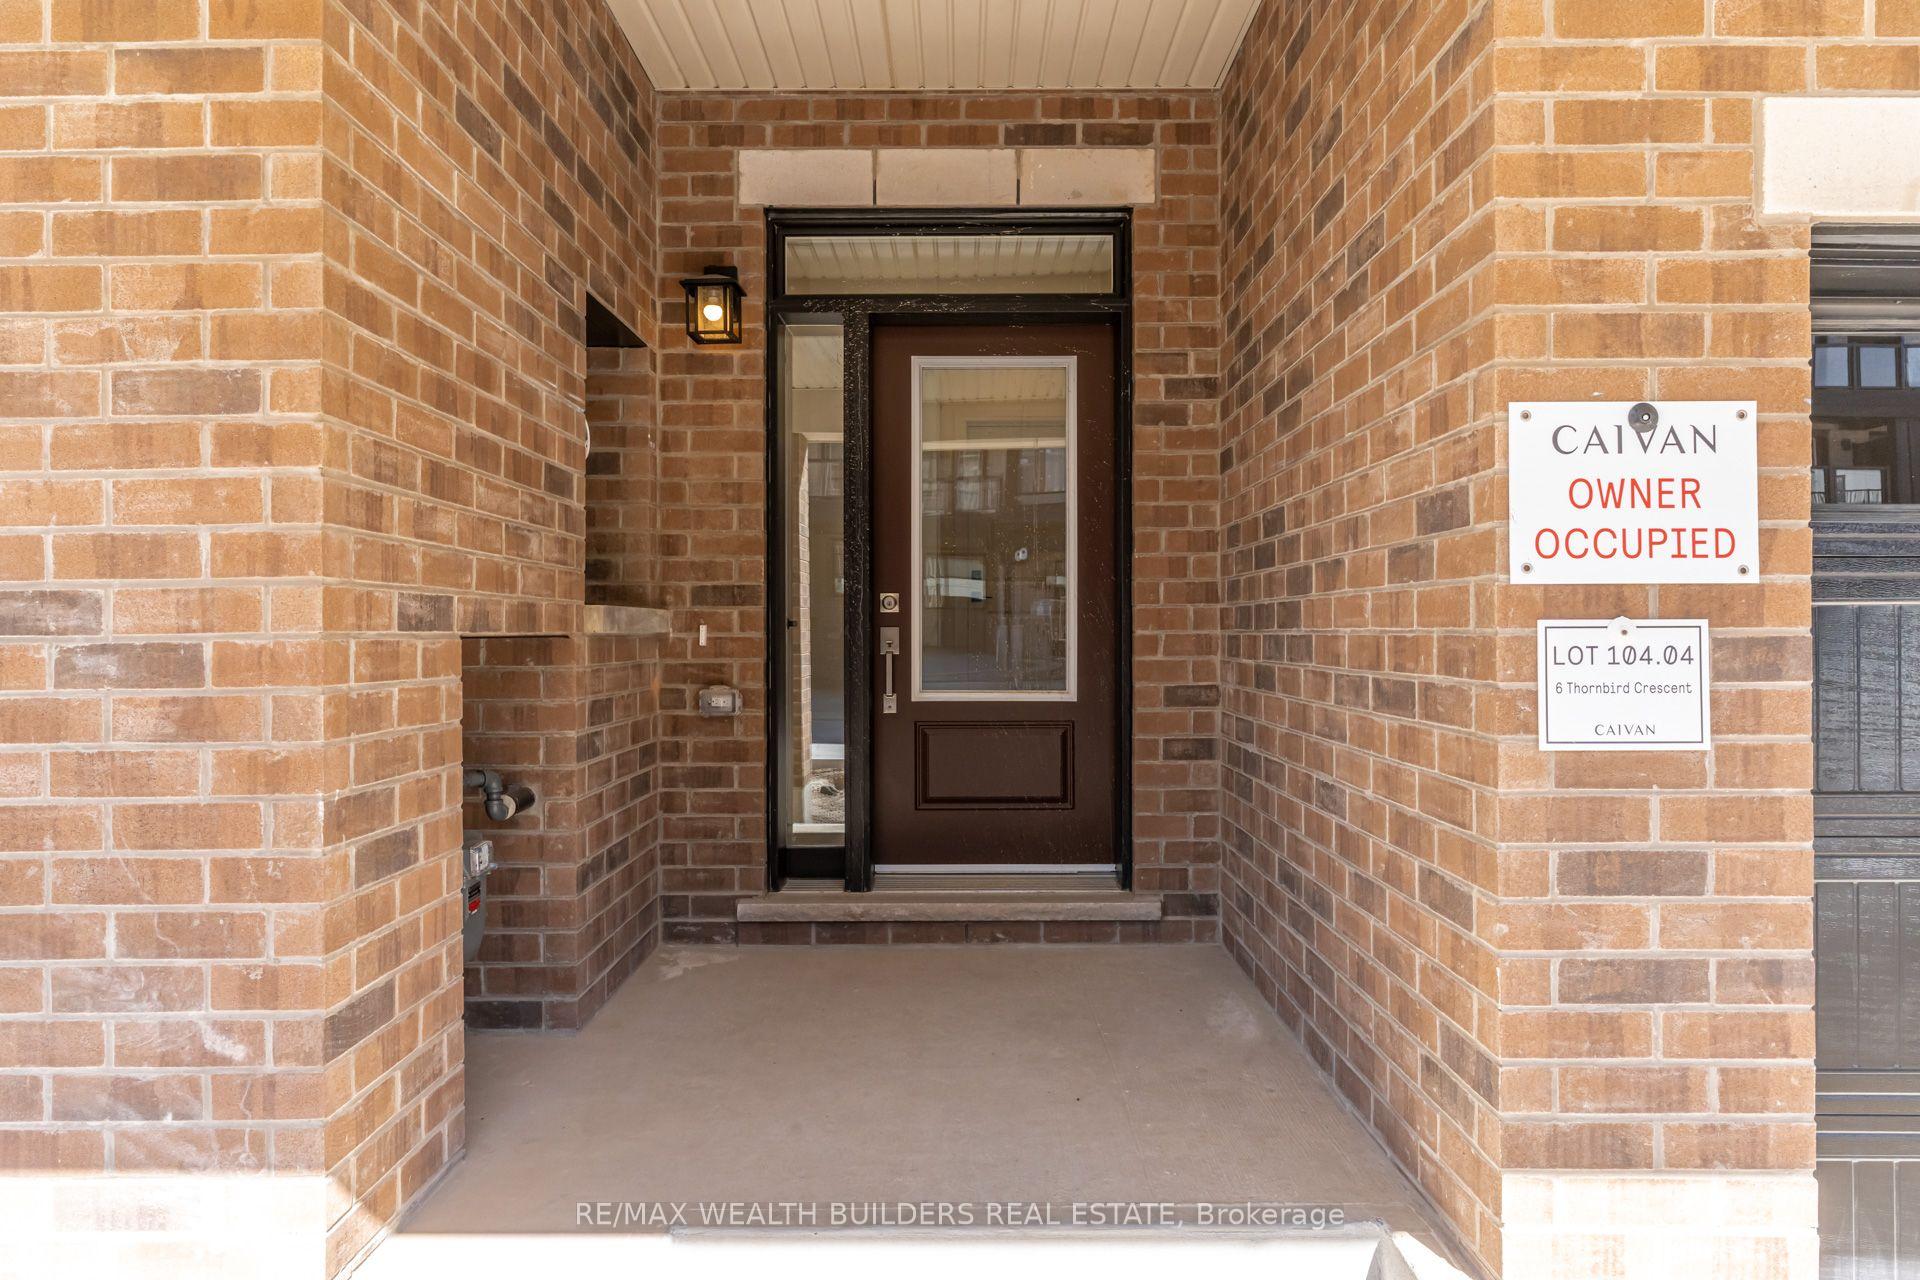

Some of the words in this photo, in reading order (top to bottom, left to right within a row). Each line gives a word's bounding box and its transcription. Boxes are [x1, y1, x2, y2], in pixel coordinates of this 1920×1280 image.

[1552, 424, 1718, 455] CAIVAN
[1568, 478, 1702, 509] OWNER
[1535, 528, 1736, 559] OCCUPIED
[1553, 645, 1599, 665] LOT
[1607, 645, 1694, 665] 104.04
[1555, 682, 1563, 694] 6
[1566, 682, 1630, 694] Thornbird
[1634, 682, 1693, 694] Crescent
[1594, 724, 1656, 736] CAIVAN
